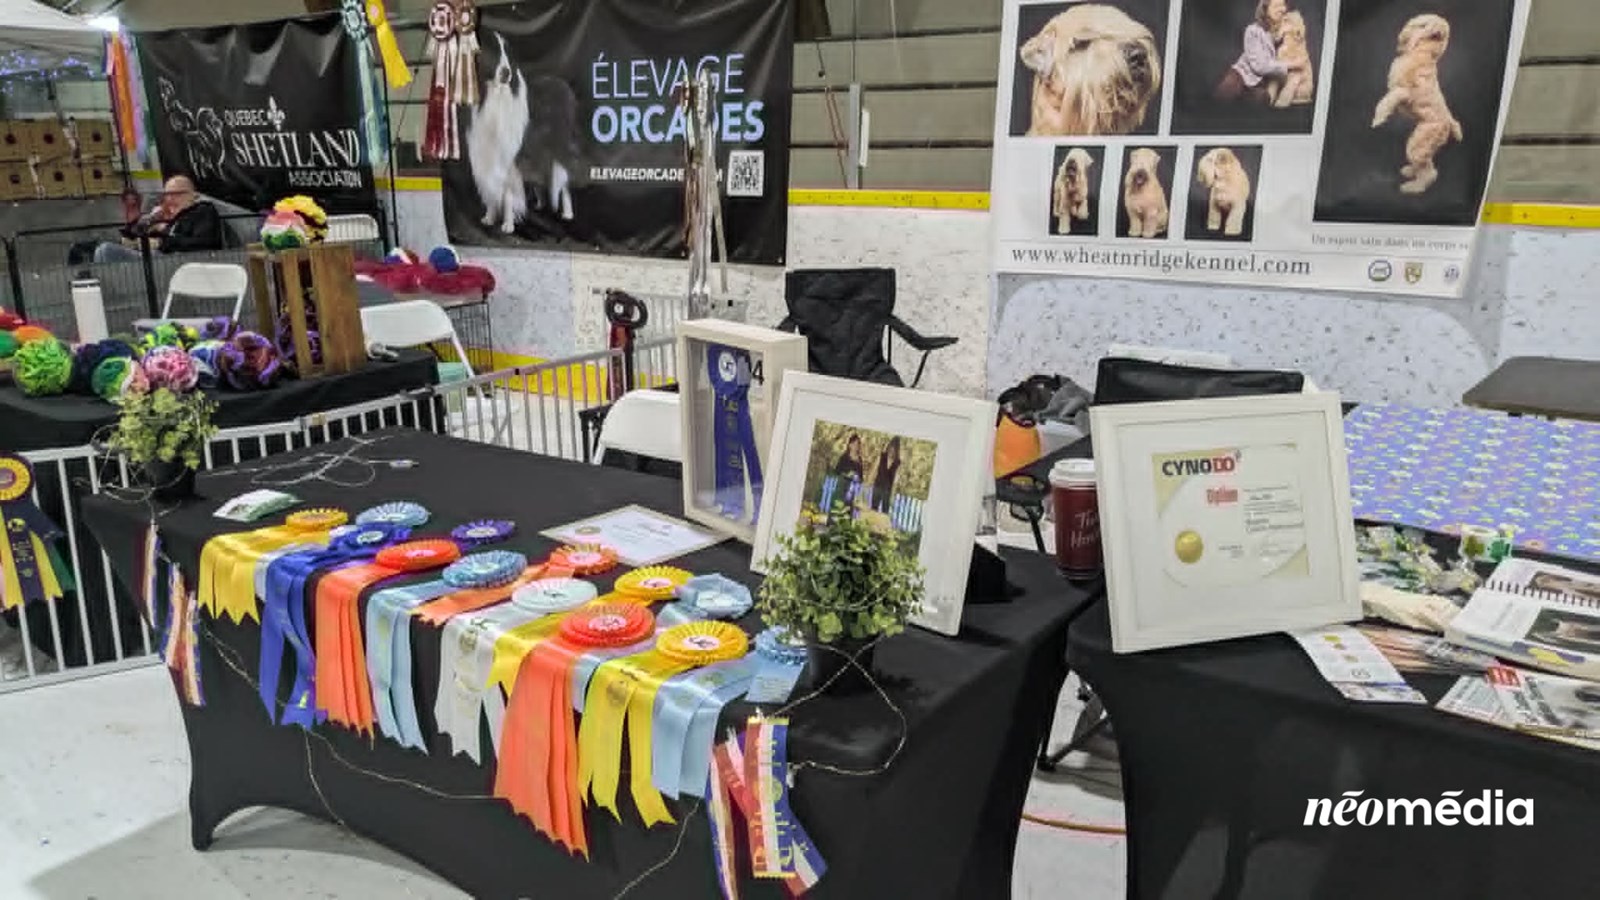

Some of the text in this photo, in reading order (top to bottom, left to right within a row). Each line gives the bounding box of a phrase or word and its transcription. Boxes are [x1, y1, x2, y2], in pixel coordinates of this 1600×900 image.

[592, 52, 744, 98] ÉLEVAGE
[231, 129, 360, 167] SHETLAND
[1012, 246, 1311, 275] www.wheatnridgekennel.com
